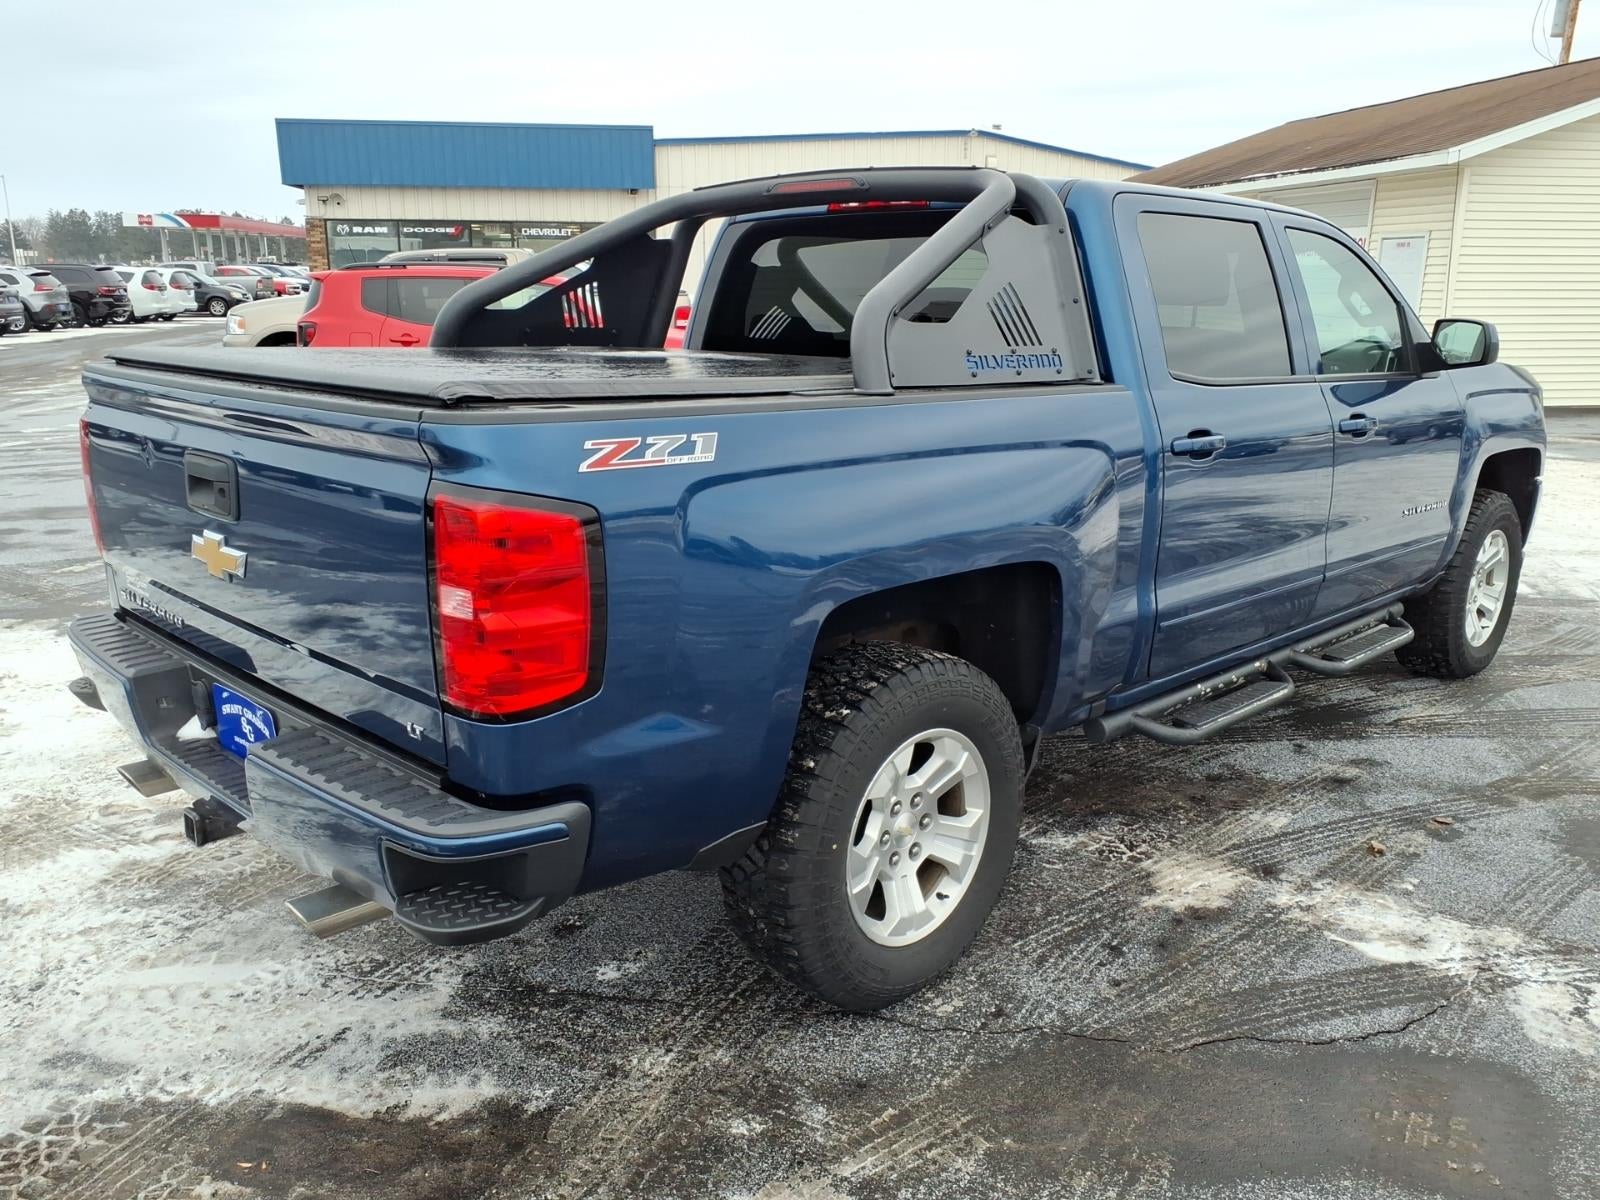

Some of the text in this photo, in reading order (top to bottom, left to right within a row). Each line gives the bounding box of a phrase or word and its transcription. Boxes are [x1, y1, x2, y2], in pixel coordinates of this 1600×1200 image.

[521, 227, 572, 236] CHEVROLET
[966, 353, 1063, 370] SILVERADO
[578, 432, 719, 472] Z71
[687, 454, 713, 462] ROAD
[407, 721, 424, 739] LT
